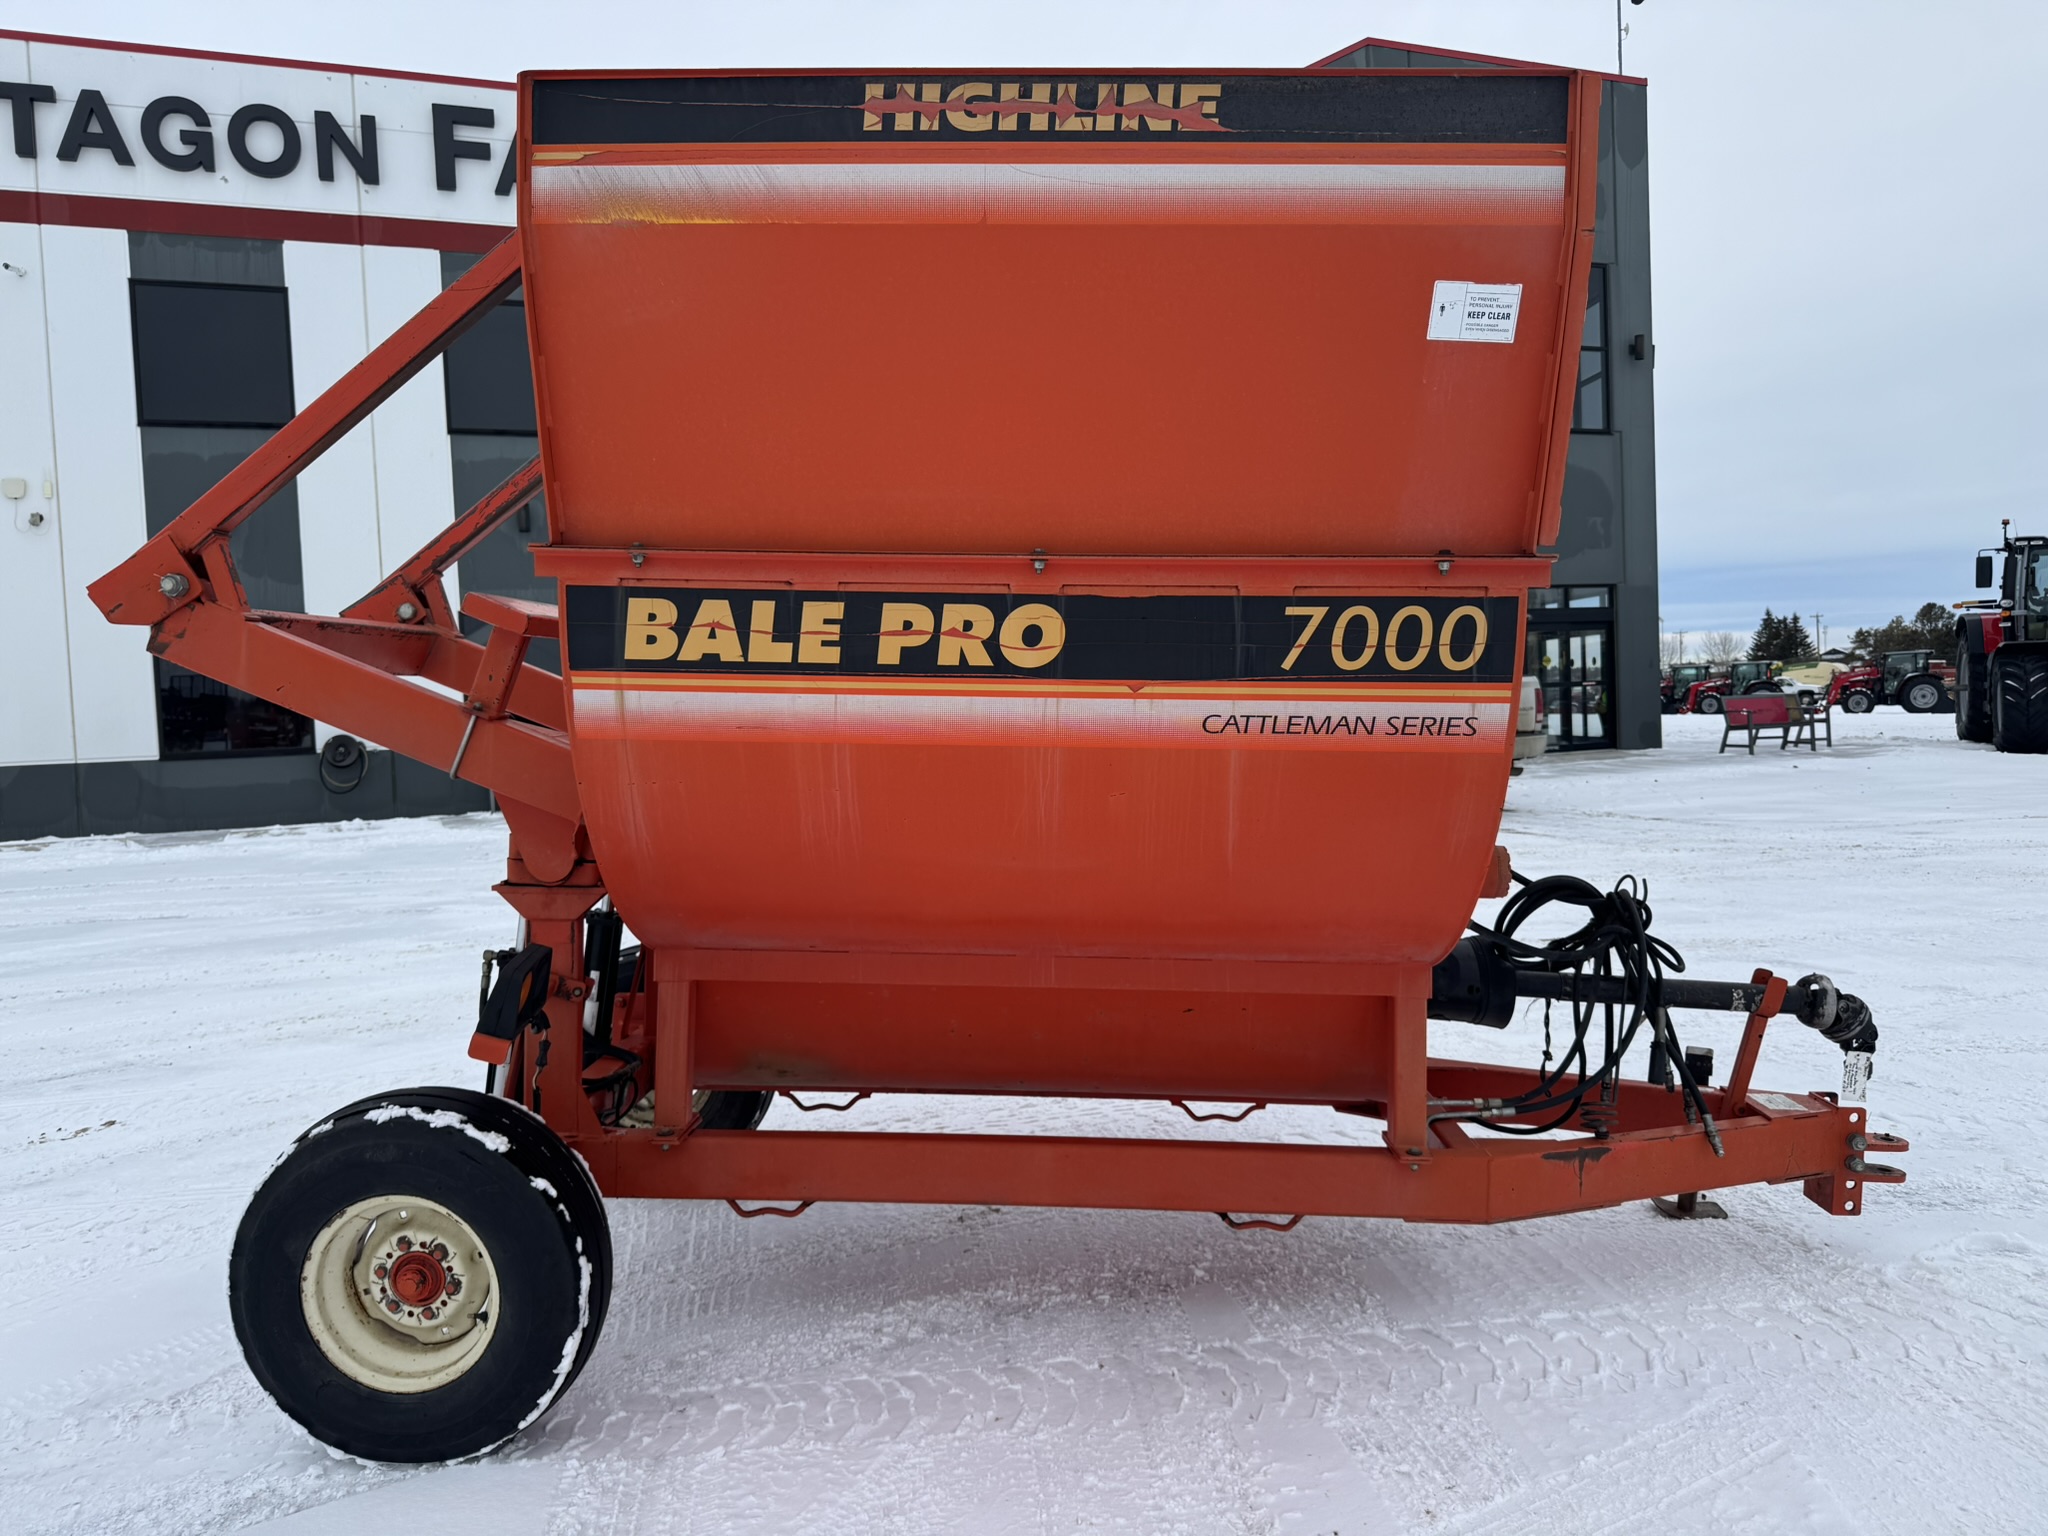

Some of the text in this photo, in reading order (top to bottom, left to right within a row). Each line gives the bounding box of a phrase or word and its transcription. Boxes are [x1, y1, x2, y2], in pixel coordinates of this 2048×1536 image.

[862, 81, 1223, 132] HIGHLINE
[0, 80, 518, 196] TAGON F
[1467, 310, 1511, 320] KEEP CLEAR
[623, 596, 1488, 672] BALE PRO 7000
[1201, 714, 1479, 737] CATTLEMAN SERIES
